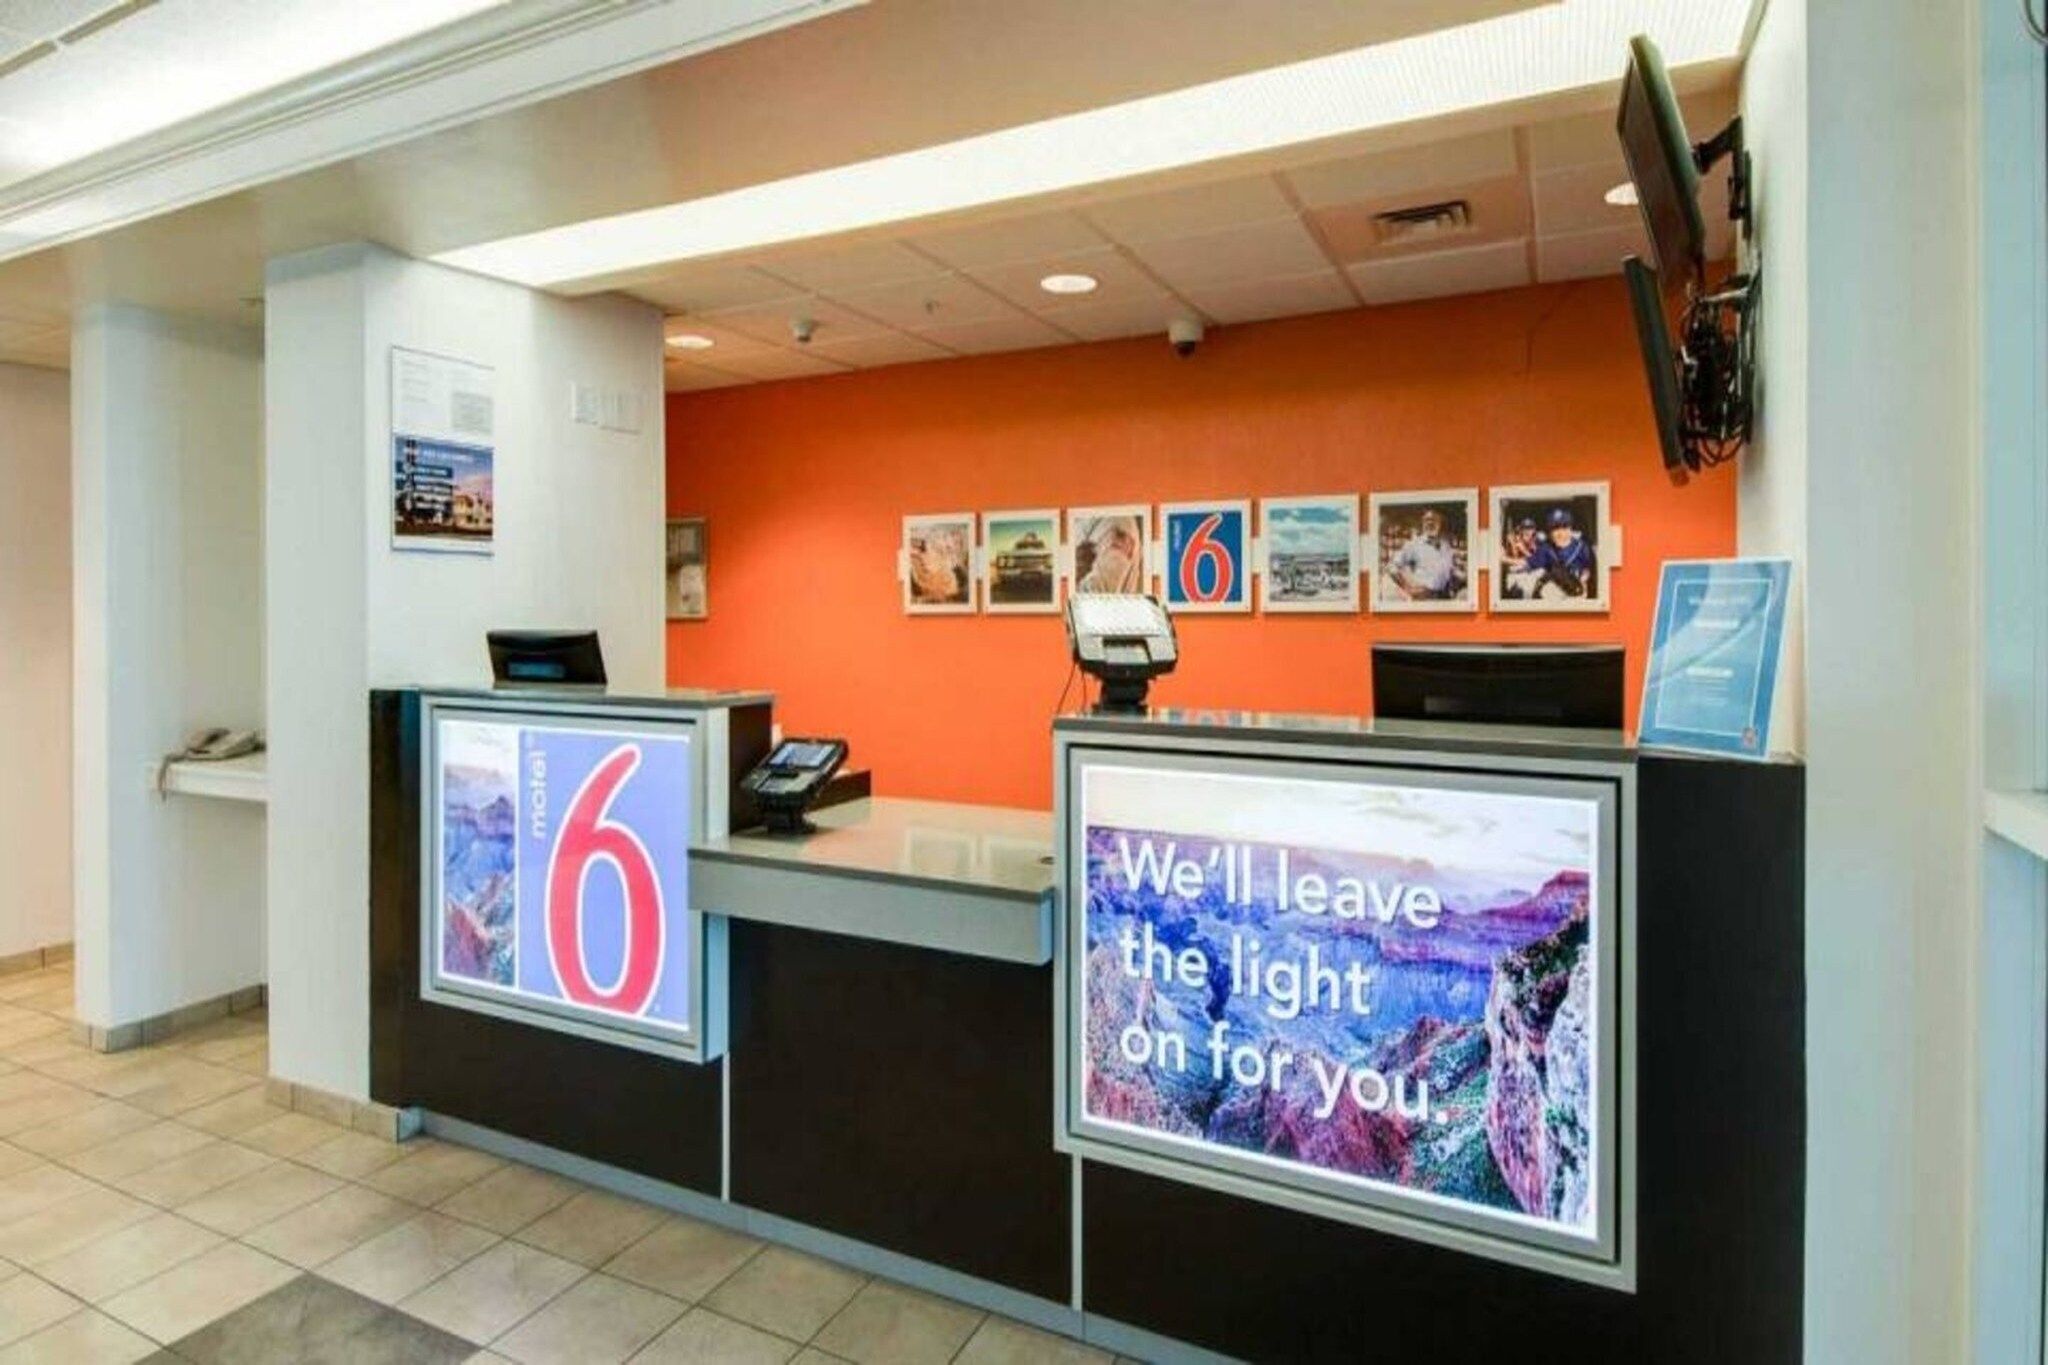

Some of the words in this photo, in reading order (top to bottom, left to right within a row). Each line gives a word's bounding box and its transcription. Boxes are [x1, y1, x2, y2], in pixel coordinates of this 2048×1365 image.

[1180, 512, 1233, 602] 6
[531, 750, 547, 839] motel
[545, 743, 666, 1018] 6
[1119, 837, 1252, 906] We'll
[1279, 849, 1443, 929] leave
[1119, 923, 1208, 987] the
[1233, 935, 1372, 1019] light
[1120, 1023, 1186, 1073] on
[1207, 1021, 1294, 1092] for
[1312, 1057, 1450, 1124] you.
